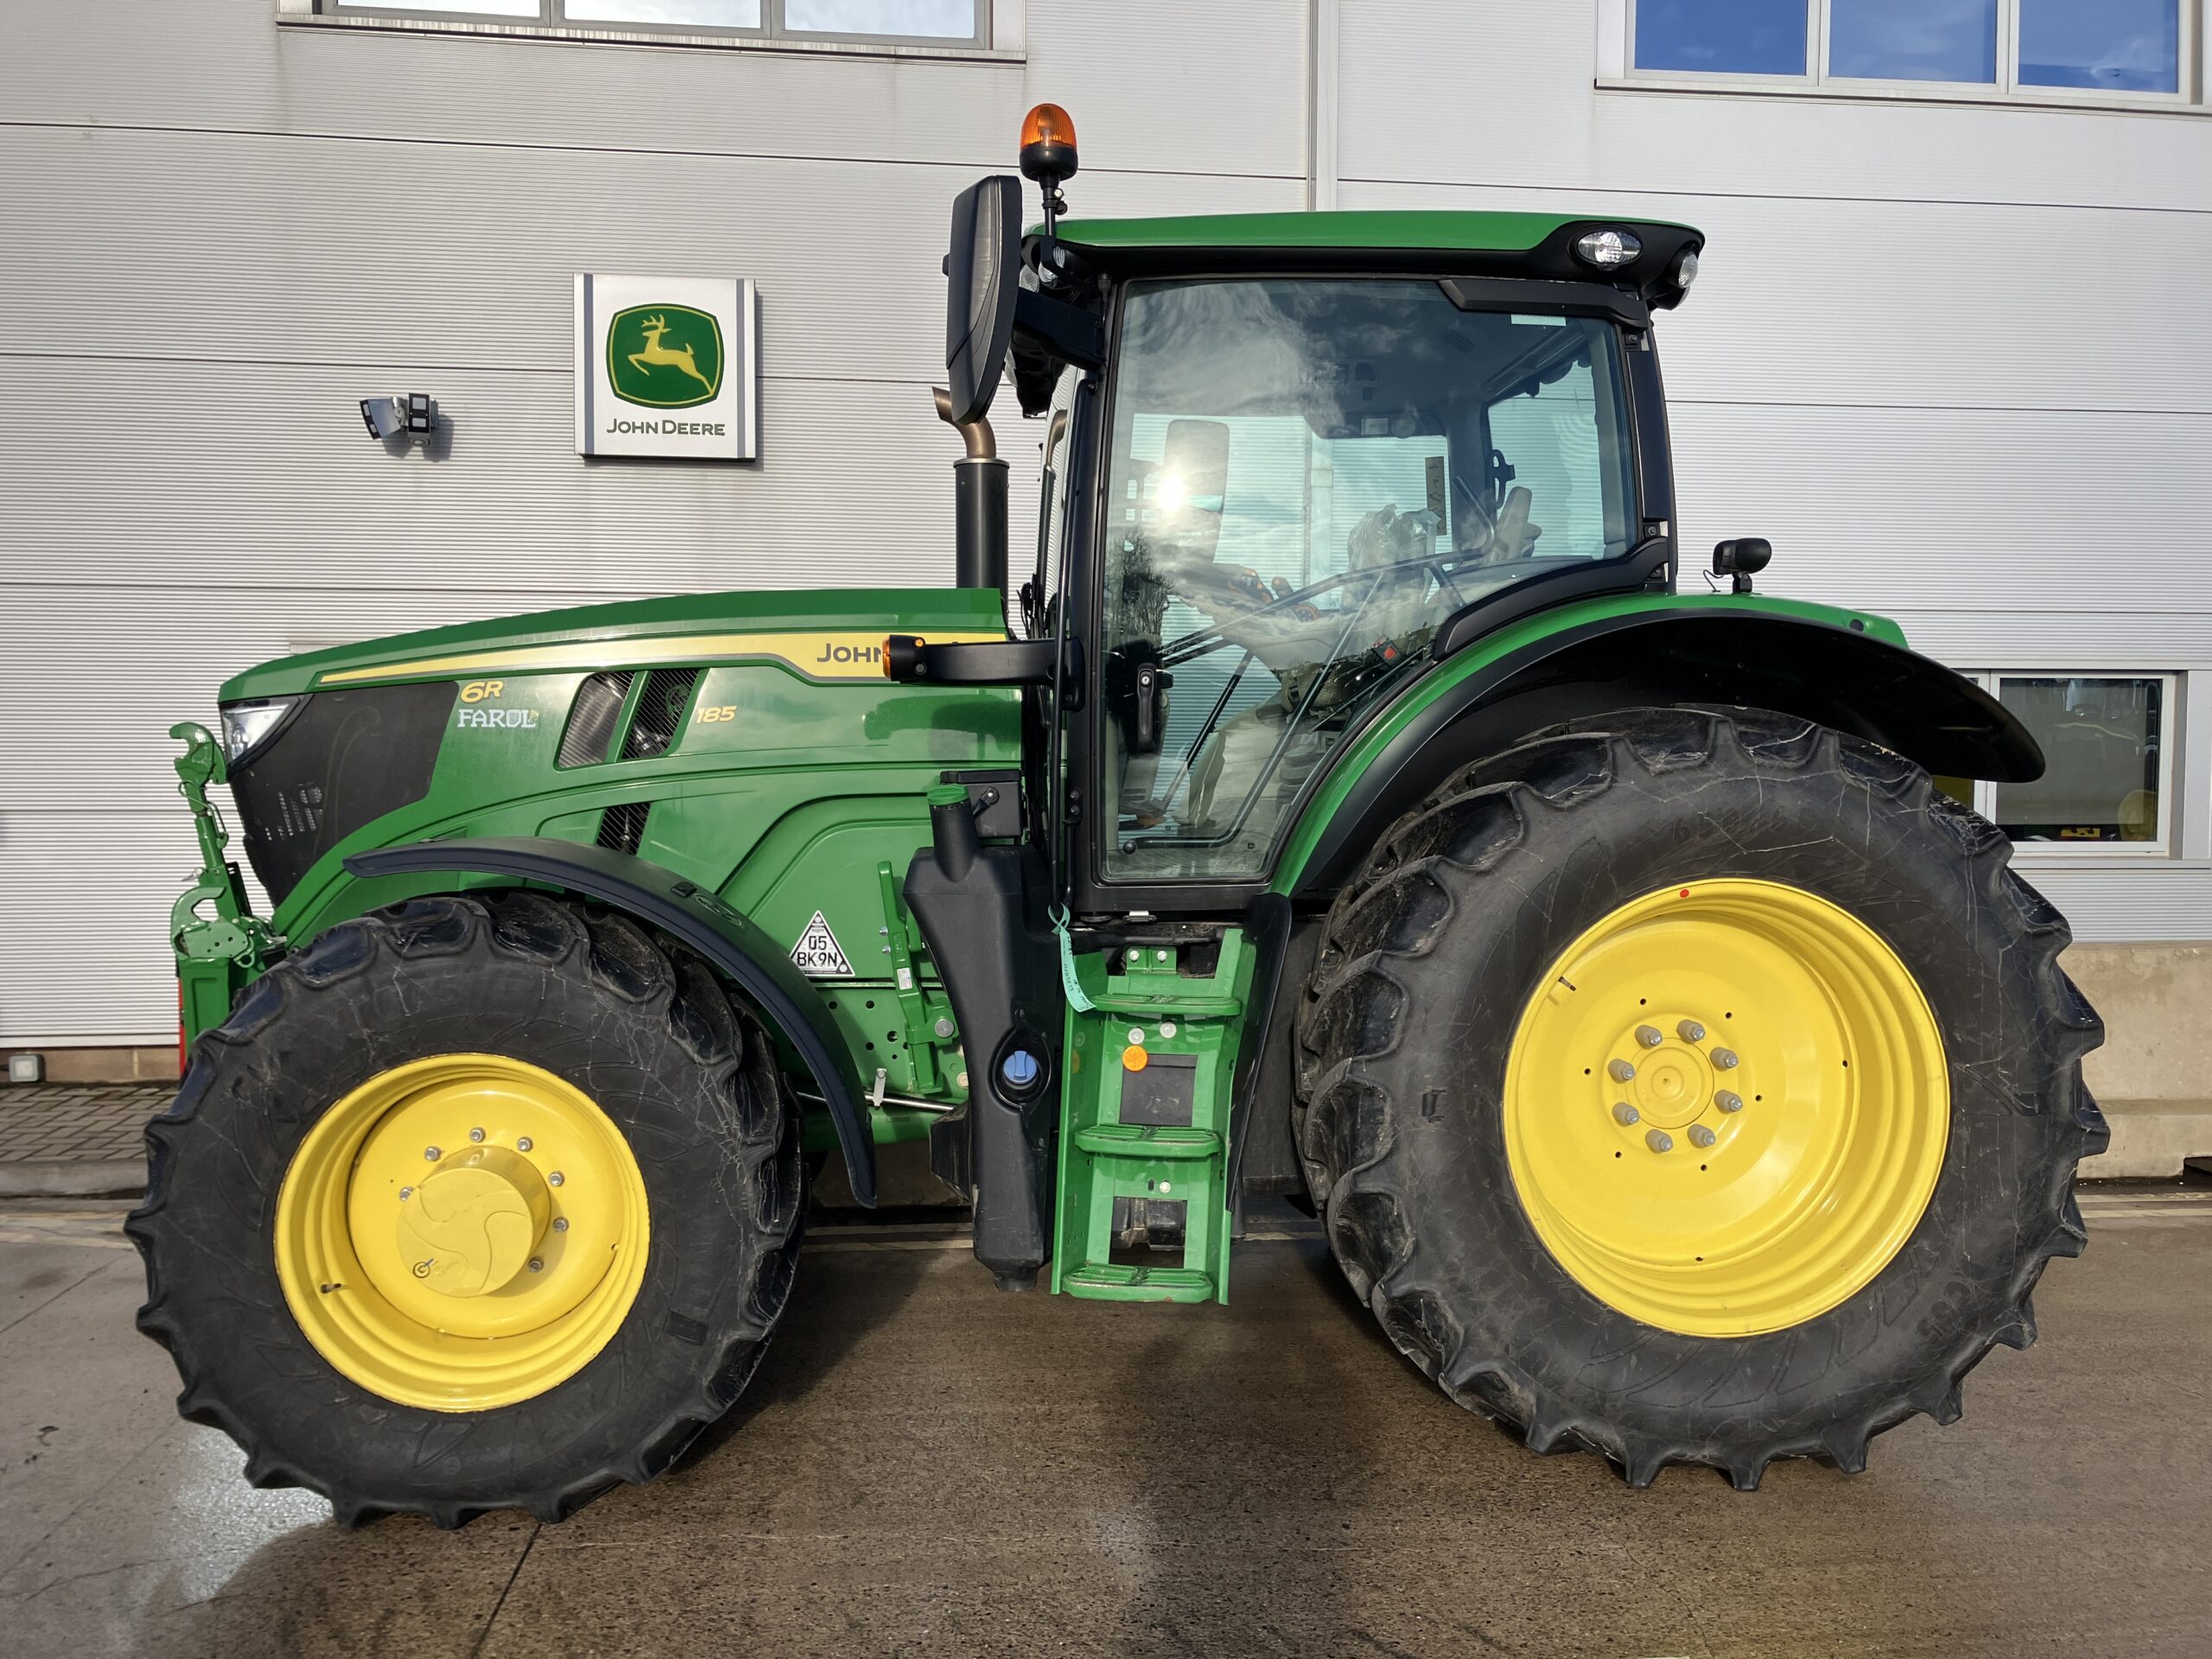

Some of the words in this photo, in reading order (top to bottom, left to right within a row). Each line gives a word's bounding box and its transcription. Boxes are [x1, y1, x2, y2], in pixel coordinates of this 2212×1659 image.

[461, 680, 504, 703] 6R
[457, 709, 537, 728] FAROL
[696, 705, 737, 724] 185
[797, 952, 837, 967] BK9N
